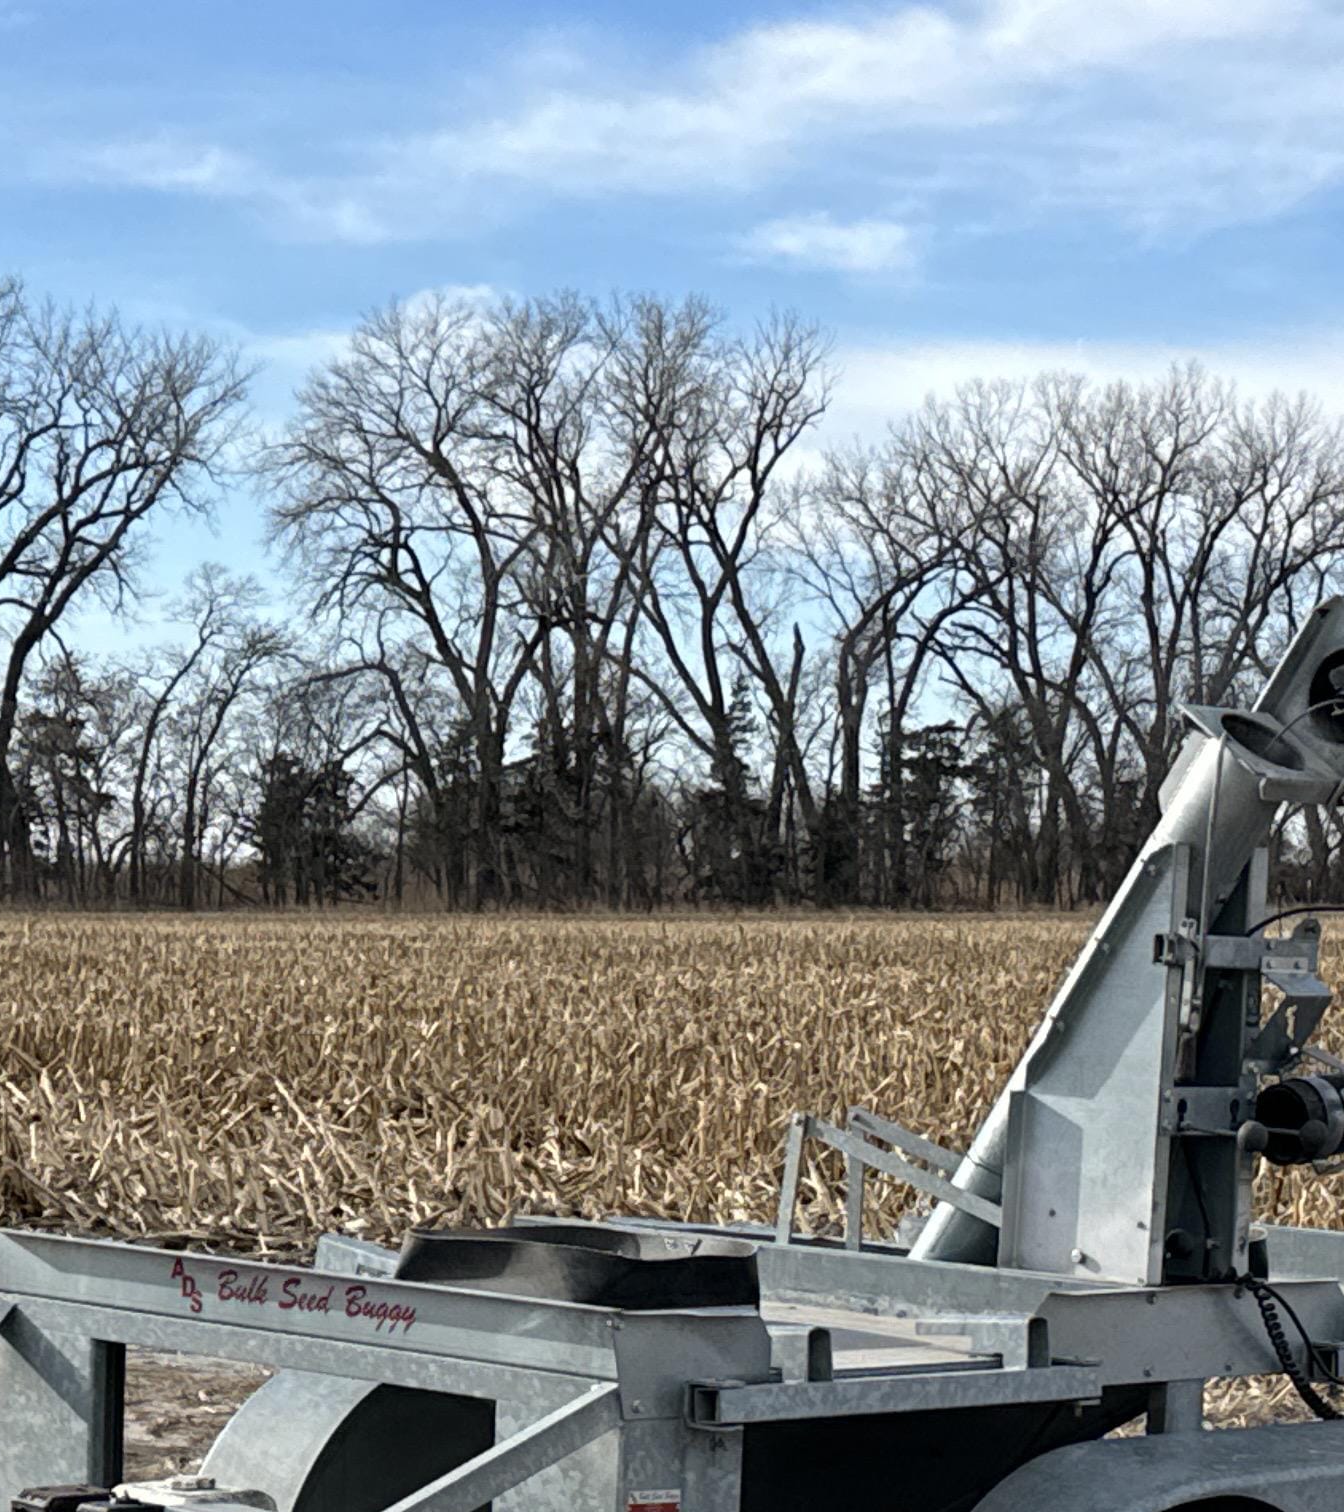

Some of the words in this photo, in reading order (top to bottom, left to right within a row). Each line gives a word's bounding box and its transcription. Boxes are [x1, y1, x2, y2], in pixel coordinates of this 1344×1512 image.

[171, 1257, 203, 1313] ADS
[217, 1269, 269, 1305] Bulk
[278, 1278, 335, 1314] Seed
[344, 1285, 417, 1333] Buggy
